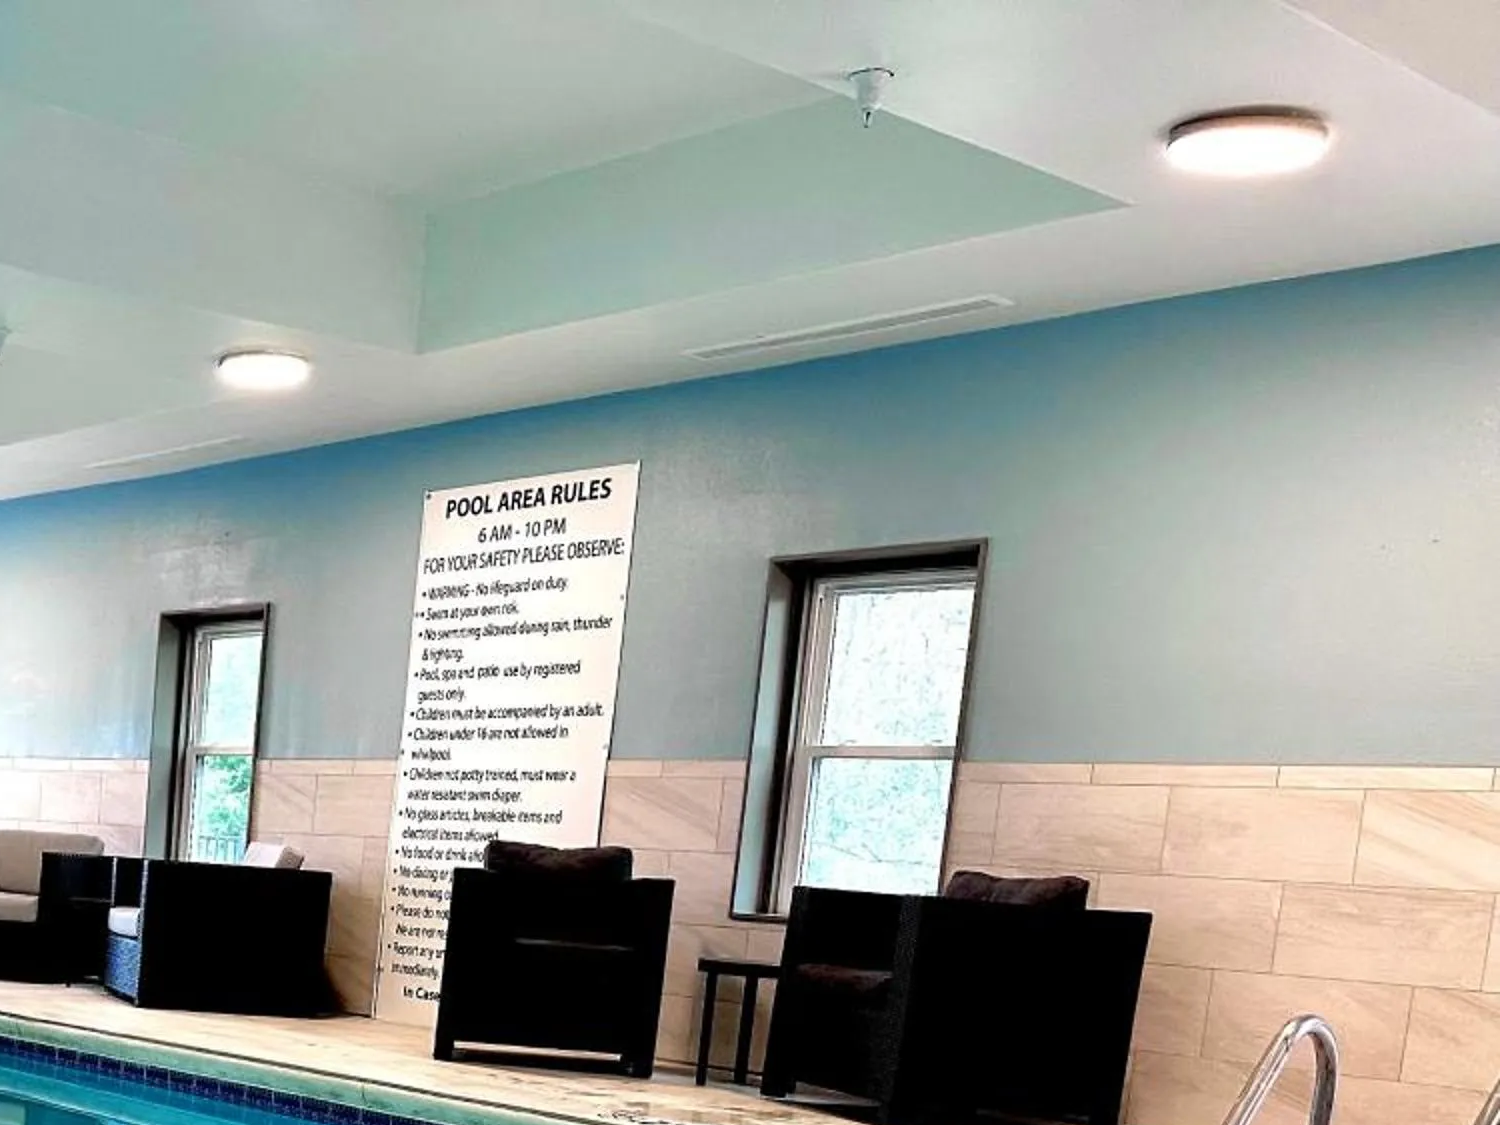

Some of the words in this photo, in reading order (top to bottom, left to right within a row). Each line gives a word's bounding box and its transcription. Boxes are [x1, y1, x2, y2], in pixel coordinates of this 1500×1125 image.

[445, 496, 493, 519] POOL
[497, 487, 546, 512] AREA
[550, 478, 613, 505] RULES
[477, 526, 487, 543] 6
[489, 524, 512, 543] AM
[524, 521, 541, 538] 10
[543, 517, 567, 536] PM
[423, 556, 445, 575] FOR
[448, 553, 477, 572] YOUR
[479, 549, 521, 569] SAFETY
[521, 543, 565, 565] PLEASE
[567, 537, 625, 560] OBSERVE:
[475, 583, 489, 597] No
[490, 577, 530, 597] lifeguard
[531, 579, 545, 591] on
[460, 606, 480, 621] your
[423, 628, 437, 640] No
[482, 621, 518, 638] allowed
[519, 620, 549, 637] during
[573, 614, 613, 630] thunder
[441, 669, 457, 682] spa
[458, 666, 474, 679] and
[477, 663, 500, 680] patio
[503, 667, 518, 678] use
[519, 662, 532, 680] by
[533, 659, 581, 680] registered
[415, 707, 451, 721] Children
[451, 708, 473, 720] must
[474, 705, 486, 720] be
[487, 704, 549, 721] accompanied
[549, 704, 562, 721] by
[562, 706, 575, 717] an
[413, 727, 449, 741] Children
[449, 727, 475, 740] under
[488, 729, 502, 740] are
[503, 726, 519, 739] not
[521, 725, 558, 740] allowed
[558, 725, 569, 738] in
[409, 767, 444, 781] Children
[445, 769, 459, 781] not
[459, 768, 485, 784] potty
[521, 768, 543, 781] must
[545, 770, 569, 782] wear
[467, 789, 490, 802] swim
[404, 807, 417, 820] No
[417, 809, 439, 823] glass
[473, 808, 517, 823] breakable
[518, 809, 543, 824] items
[543, 810, 563, 825] and
[439, 827, 463, 841] items
[401, 845, 412, 859] No
[414, 846, 435, 860] food
[435, 850, 444, 861] or
[445, 848, 467, 861] drink
[398, 884, 409, 897] No
[396, 903, 420, 918] Please
[422, 905, 434, 918] do
[394, 941, 418, 956] Report
[403, 986, 413, 998] In
